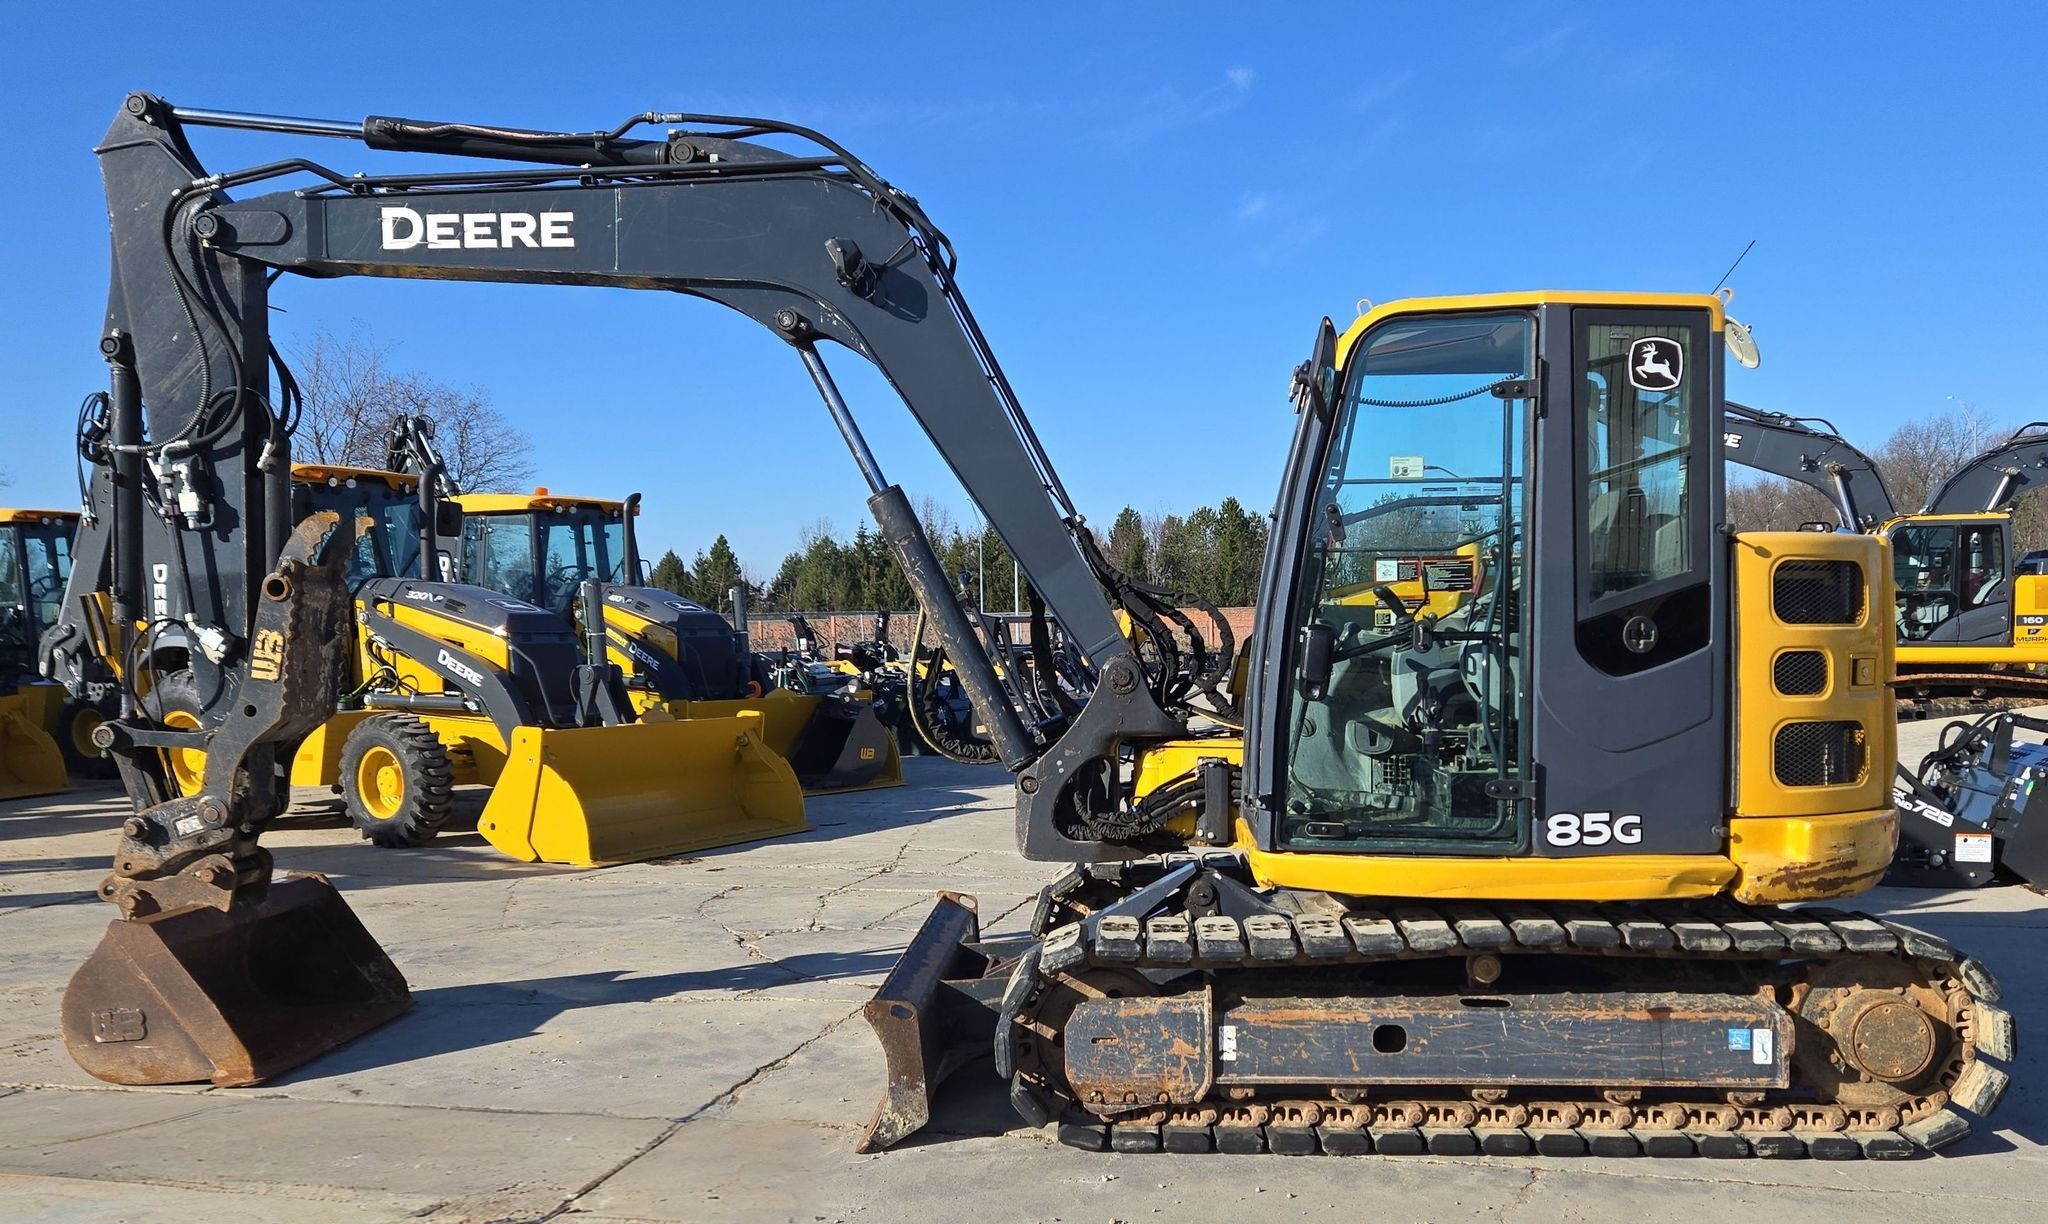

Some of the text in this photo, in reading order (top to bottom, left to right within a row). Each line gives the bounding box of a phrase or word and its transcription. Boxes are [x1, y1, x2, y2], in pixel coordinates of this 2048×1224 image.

[380, 207, 575, 250] DEERE
[153, 563, 168, 639] DEER
[2022, 616, 2044, 624] 160
[436, 648, 484, 688] DEERE
[628, 642, 660, 671] DEERE
[1546, 812, 1642, 847] 85G
